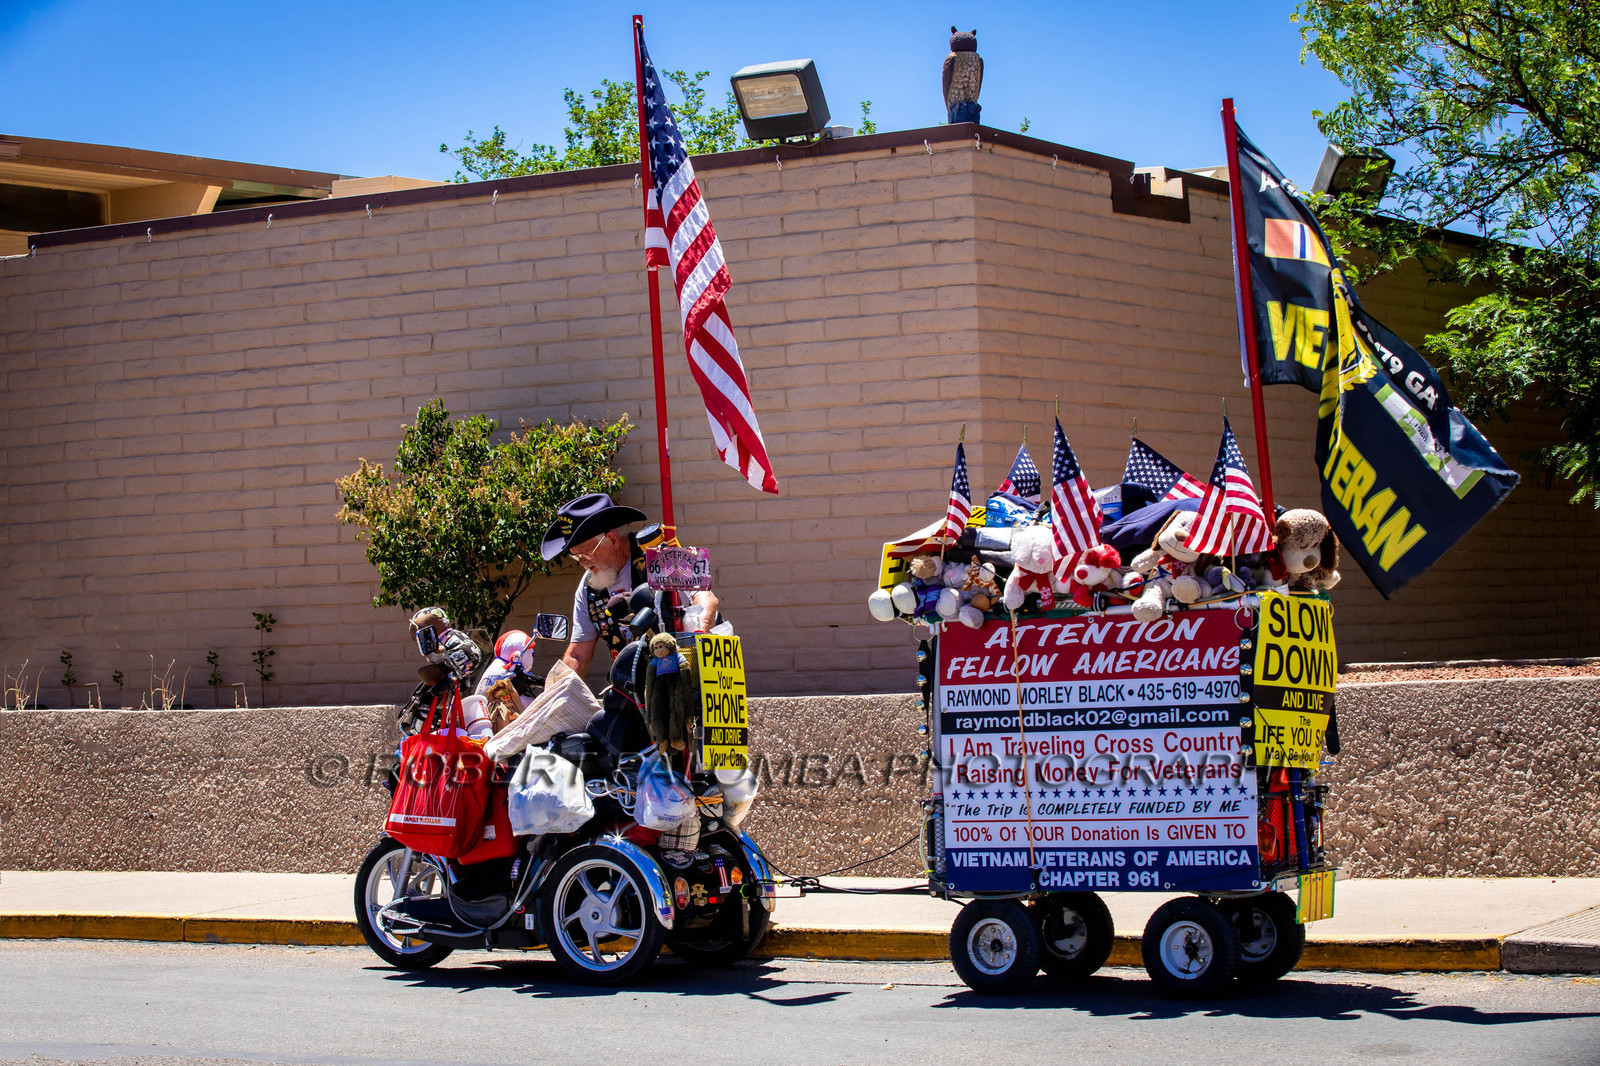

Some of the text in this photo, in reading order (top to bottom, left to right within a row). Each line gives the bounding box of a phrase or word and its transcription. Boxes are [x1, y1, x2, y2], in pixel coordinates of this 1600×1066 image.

[1404, 370, 1439, 412] GA
[1322, 424, 1428, 573] TERAN
[649, 560, 661, 574] 66
[693, 560, 706, 575] 67
[1268, 597, 1329, 644] SLOW
[984, 617, 1206, 649] ATTENTION
[700, 637, 742, 670] PARK
[946, 645, 1240, 679] FELLOW AMERICANS
[1262, 643, 1334, 688] DOWN
[717, 671, 733, 690] Your
[946, 687, 1011, 707] RAYMOND
[1017, 685, 1073, 705] MORLEY
[1281, 690, 1324, 711] AND LIVE
[705, 692, 746, 725] PHONE
[955, 709, 1230, 731] raymondblack02@gmail.com
[1299, 715, 1311, 727] The
[710, 728, 742, 745] AND DRIVE
[949, 731, 1242, 759] I Am Traveling Cross Country
[1254, 725, 1285, 745] LIFE
[1290, 727, 1312, 747] YOU
[709, 748, 744, 767] Your Car
[1264, 747, 1285, 762] May
[1288, 748, 1299, 761] Be
[1301, 749, 1315, 762] Your
[956, 759, 1242, 787] Raising Money For Veterans
[986, 803, 1013, 819] Trip
[1018, 803, 1031, 816] Is
[1037, 801, 1122, 816] COMPLETELY
[1128, 801, 1186, 815] FUNDED
[1192, 800, 1212, 814] BY
[953, 823, 1246, 842] 100% Of YOUR Donation Is GIVEN TO
[951, 849, 1252, 868] VIETNAM VETERANS OF AMERICA
[1038, 871, 1160, 888] CHAPTER 961
